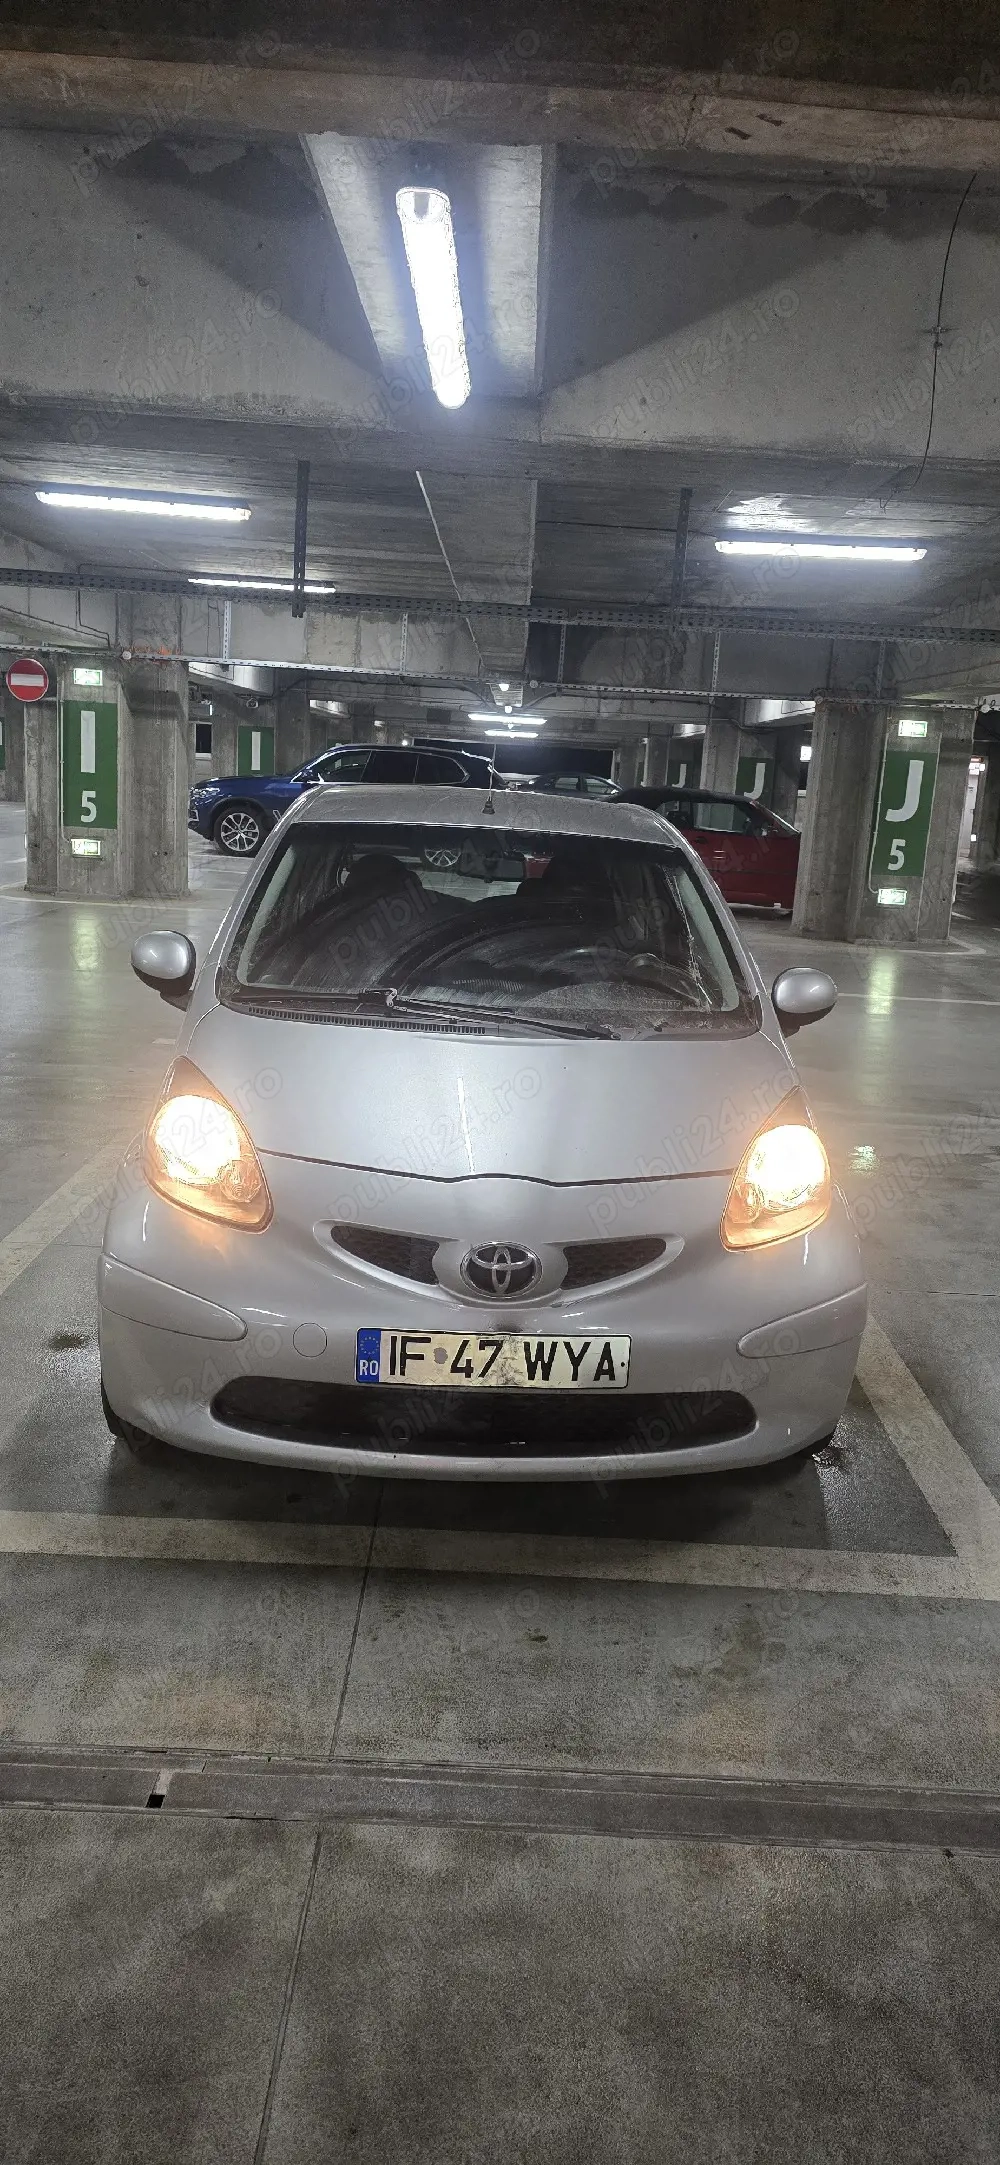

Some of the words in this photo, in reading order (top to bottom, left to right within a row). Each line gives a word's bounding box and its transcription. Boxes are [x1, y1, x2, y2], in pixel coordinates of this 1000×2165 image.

[744, 762, 766, 800] J
[885, 759, 925, 822] J
[80, 790, 97, 823] 5
[887, 838, 906, 871] 5
[359, 1359, 379, 1376] RO
[389, 1335, 431, 1377] IF
[450, 1339, 504, 1379] 47
[522, 1340, 616, 1381] WYA
